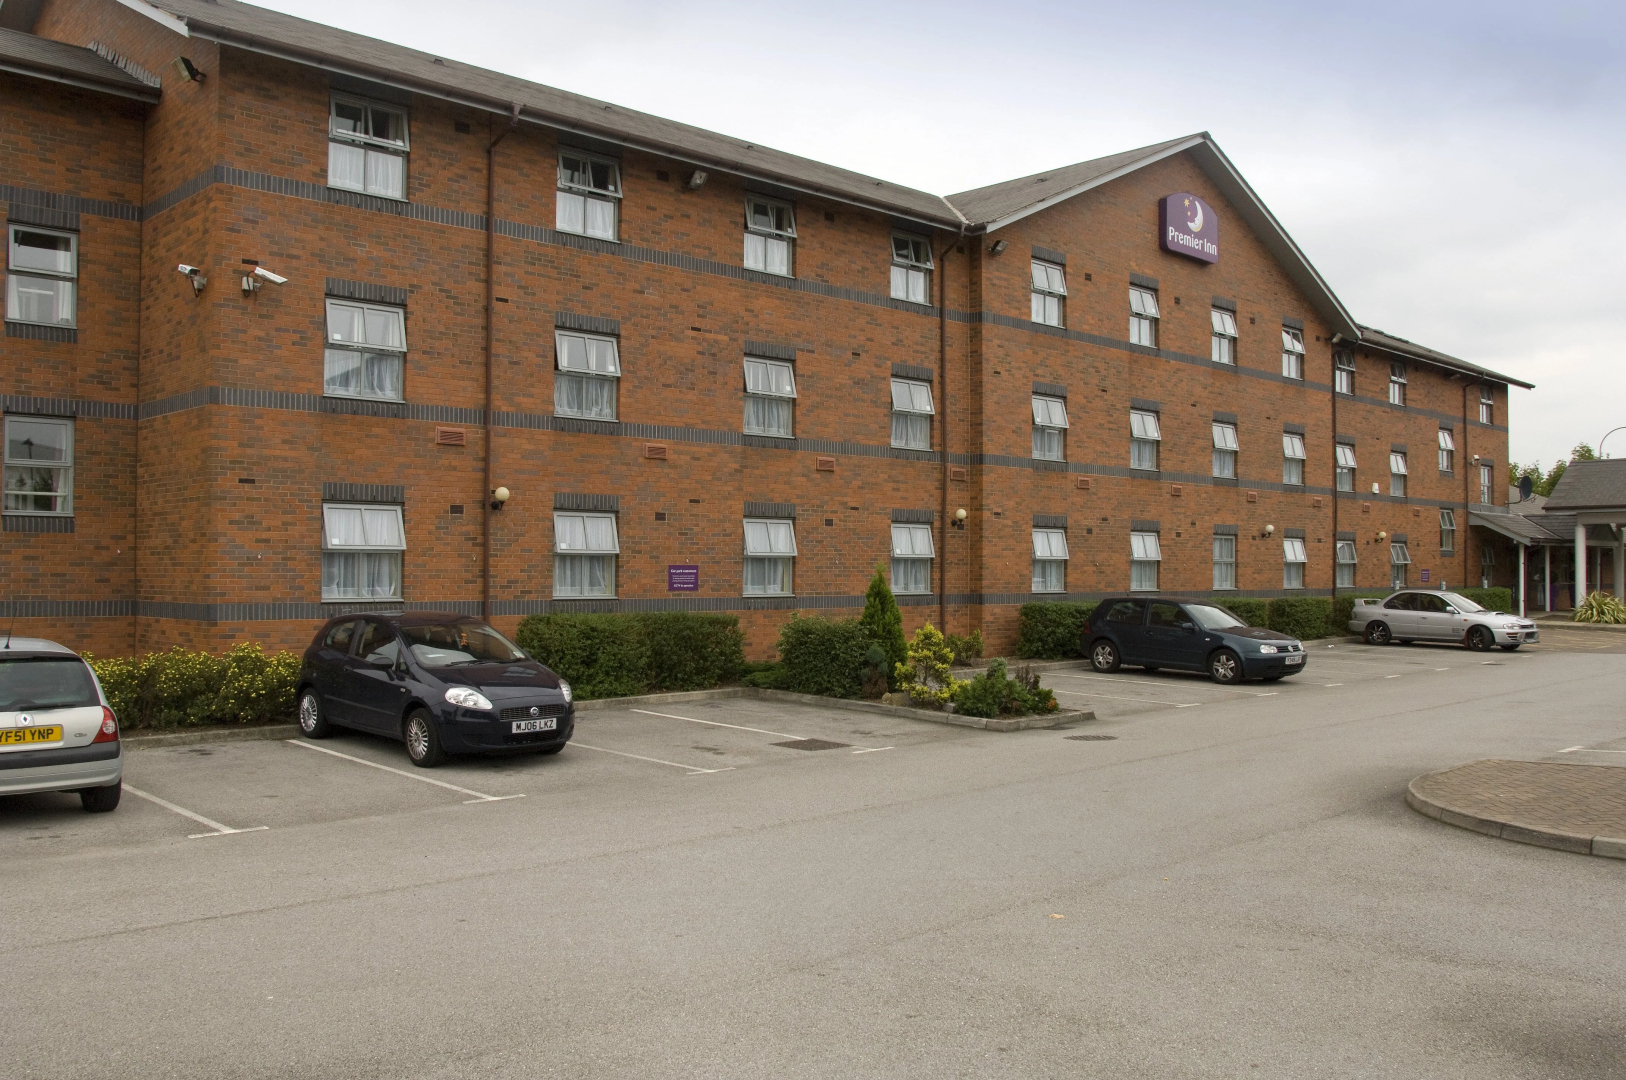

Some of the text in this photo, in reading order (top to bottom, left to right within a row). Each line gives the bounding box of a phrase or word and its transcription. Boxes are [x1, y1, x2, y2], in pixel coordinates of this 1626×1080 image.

[1168, 226, 1217, 256] Premier Inn
[515, 719, 554, 732] MJ06 LKZ
[0, 728, 54, 743] YF51 YNP
